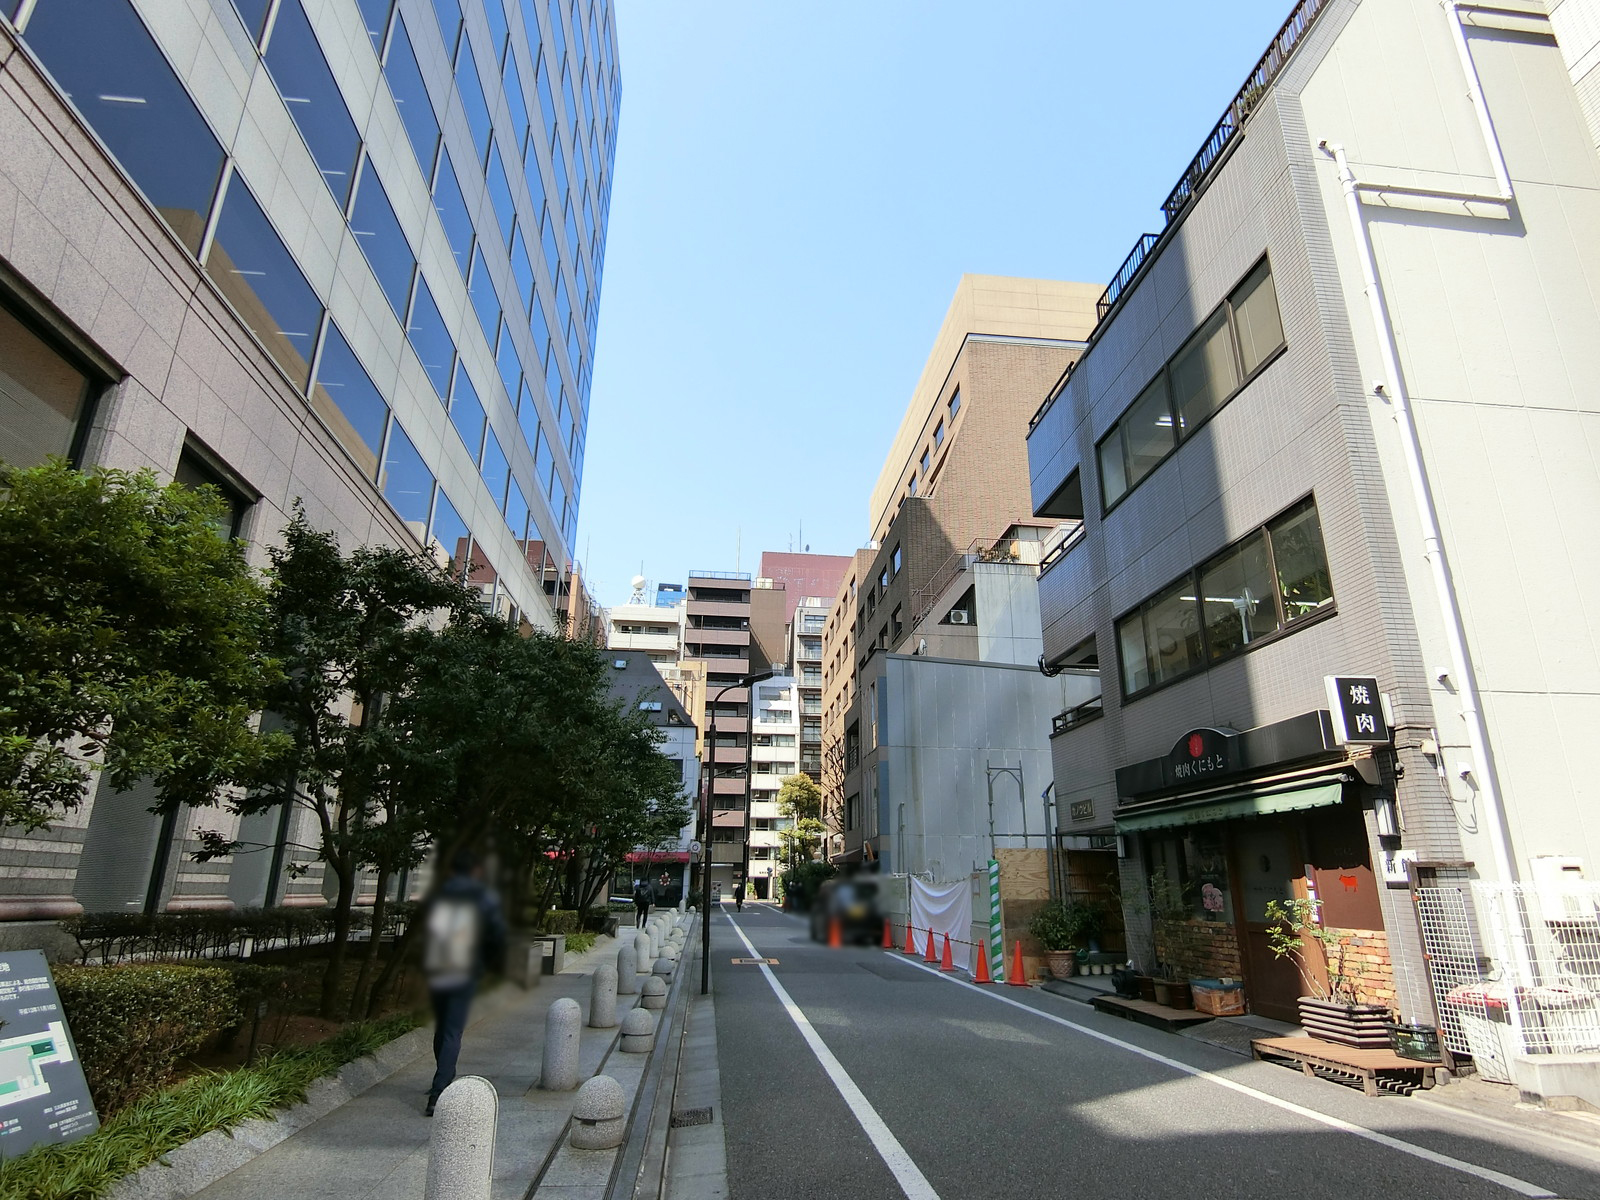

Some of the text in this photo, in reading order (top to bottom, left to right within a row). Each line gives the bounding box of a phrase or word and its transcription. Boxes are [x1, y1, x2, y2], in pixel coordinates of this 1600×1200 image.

[1350, 685, 1375, 733] 焼肉
[1175, 754, 1223, 778] 焼肉くにもと
